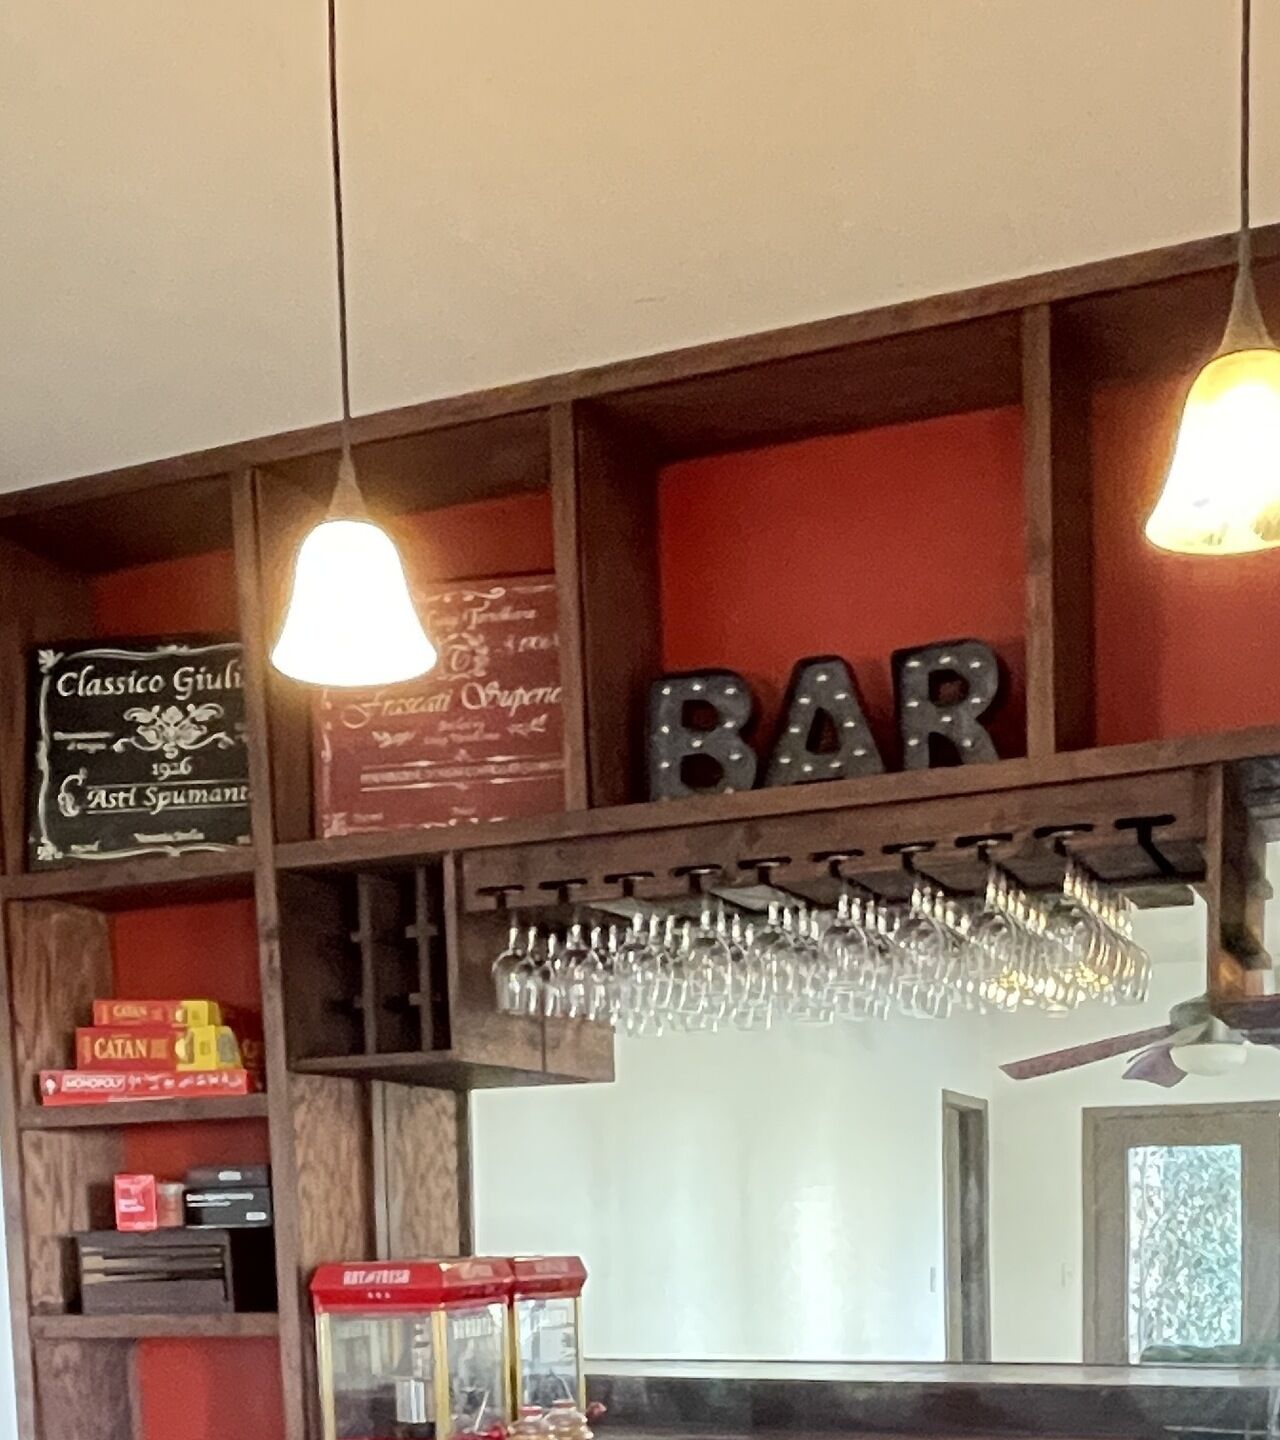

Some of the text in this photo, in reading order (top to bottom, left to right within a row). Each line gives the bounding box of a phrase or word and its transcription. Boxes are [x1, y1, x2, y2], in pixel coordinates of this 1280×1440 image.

[56, 664, 166, 697] Classico
[648, 639, 1001, 801] BAR
[151, 756, 193, 781] 1926
[94, 1037, 148, 1060] CATAN
[64, 1074, 125, 1089] MONOPOLY
